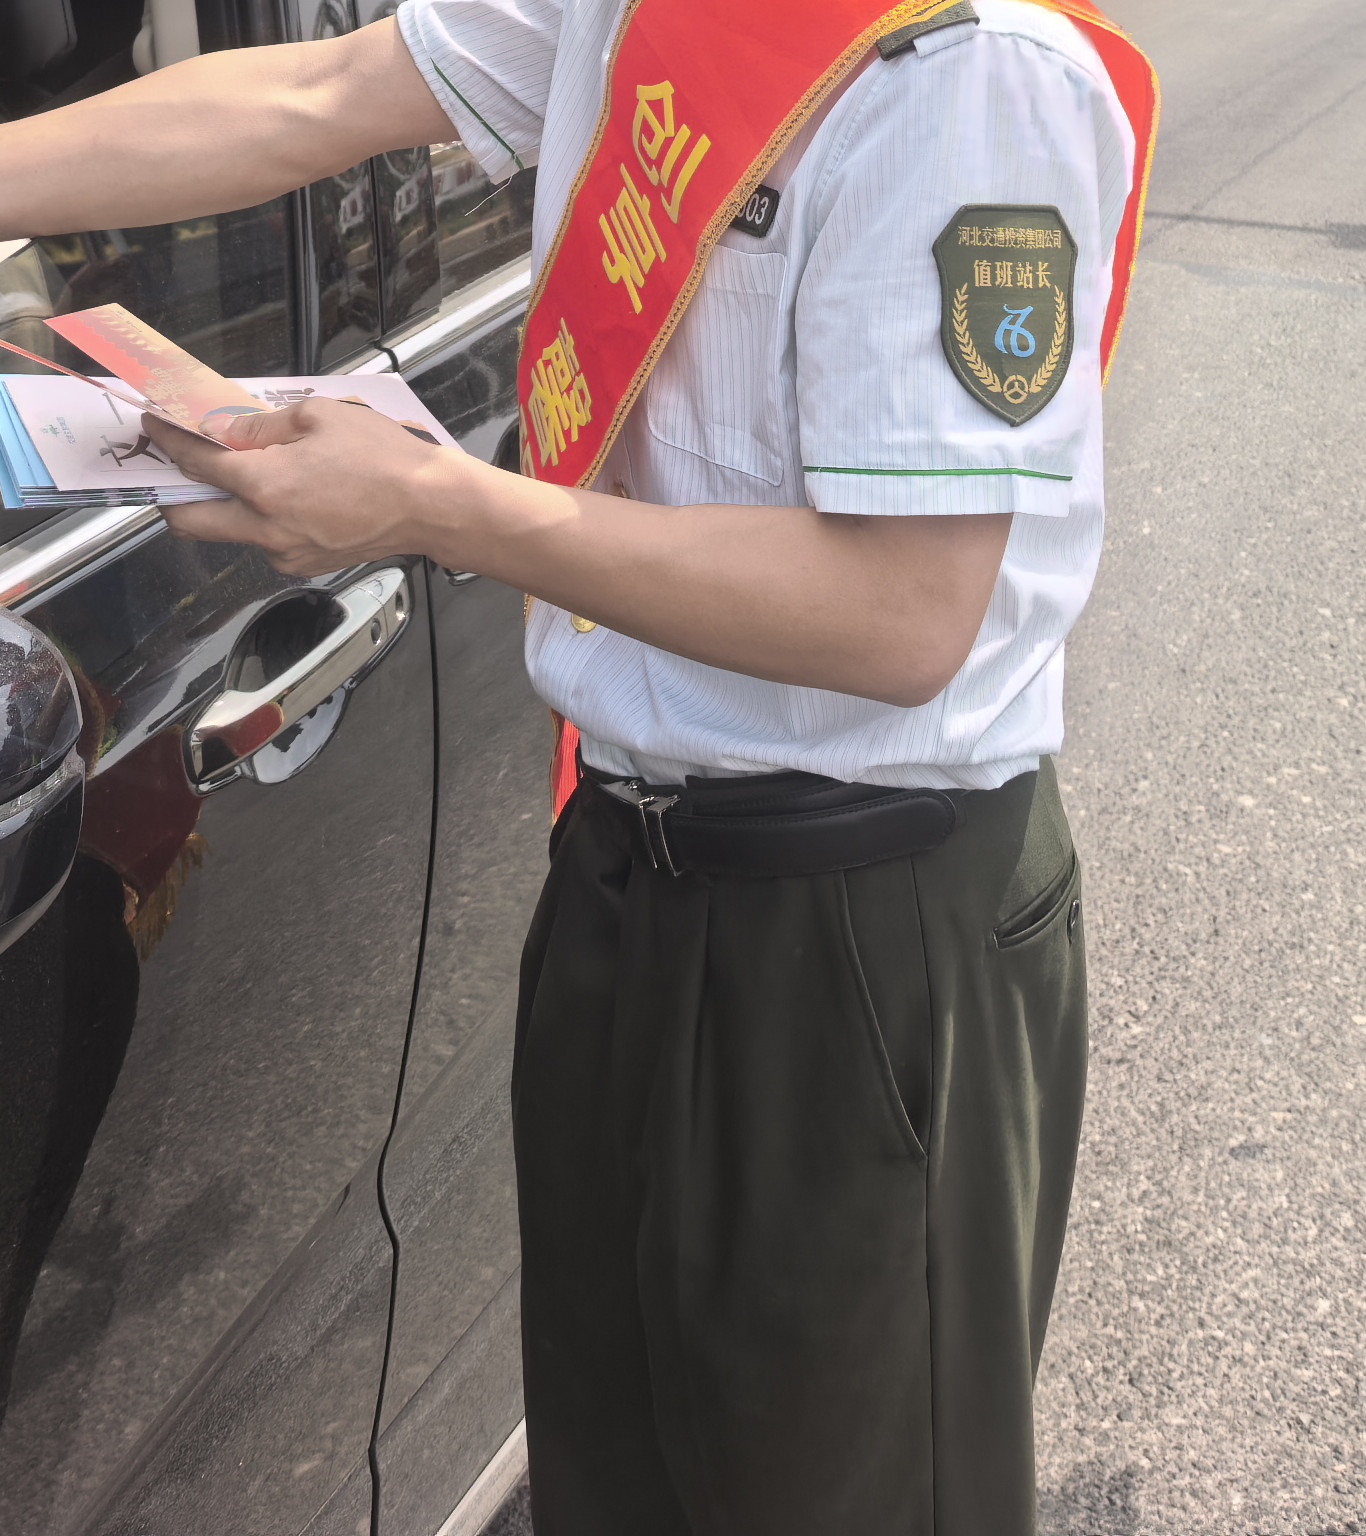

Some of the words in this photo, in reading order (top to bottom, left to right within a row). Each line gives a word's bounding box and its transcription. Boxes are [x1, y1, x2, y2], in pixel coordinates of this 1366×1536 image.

[957, 226, 1062, 250] 河北交通投资集团公司
[973, 259, 1052, 289] 值班站长
